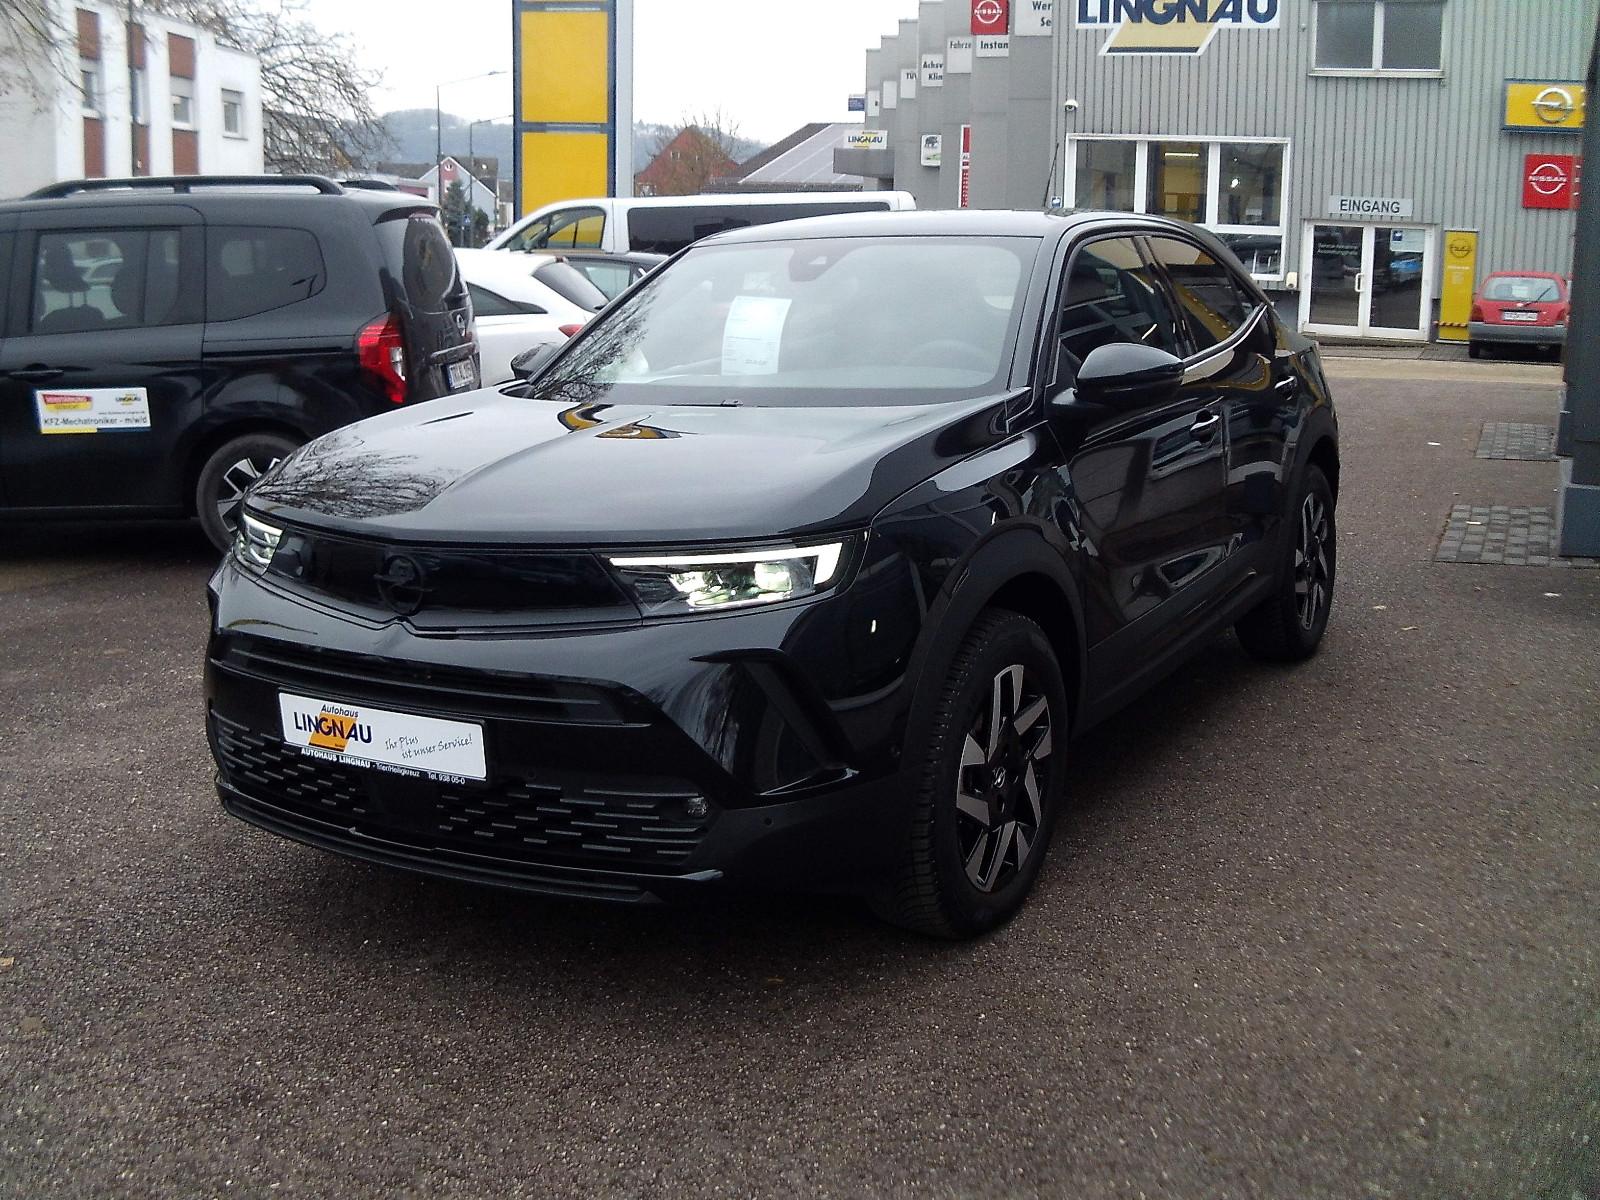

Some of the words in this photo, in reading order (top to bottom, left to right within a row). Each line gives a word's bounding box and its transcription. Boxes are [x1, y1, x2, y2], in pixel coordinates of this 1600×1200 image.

[1078, 0, 1278, 25] LINGNAU
[847, 135, 883, 144] LINGNAU
[1340, 199, 1400, 213] EINGANG
[44, 416, 118, 426] KFZ-Mechatroniker
[321, 704, 359, 718] Autohaus
[294, 711, 373, 744] LINGNAU
[385, 738, 398, 750] Ihr
[399, 735, 419, 749] Plus
[402, 750, 412, 759] ist
[415, 745, 436, 756] unser
[438, 733, 473, 751] Service!
[301, 747, 338, 762] AUTOHAUS
[339, 755, 371, 769] LINGNAU
